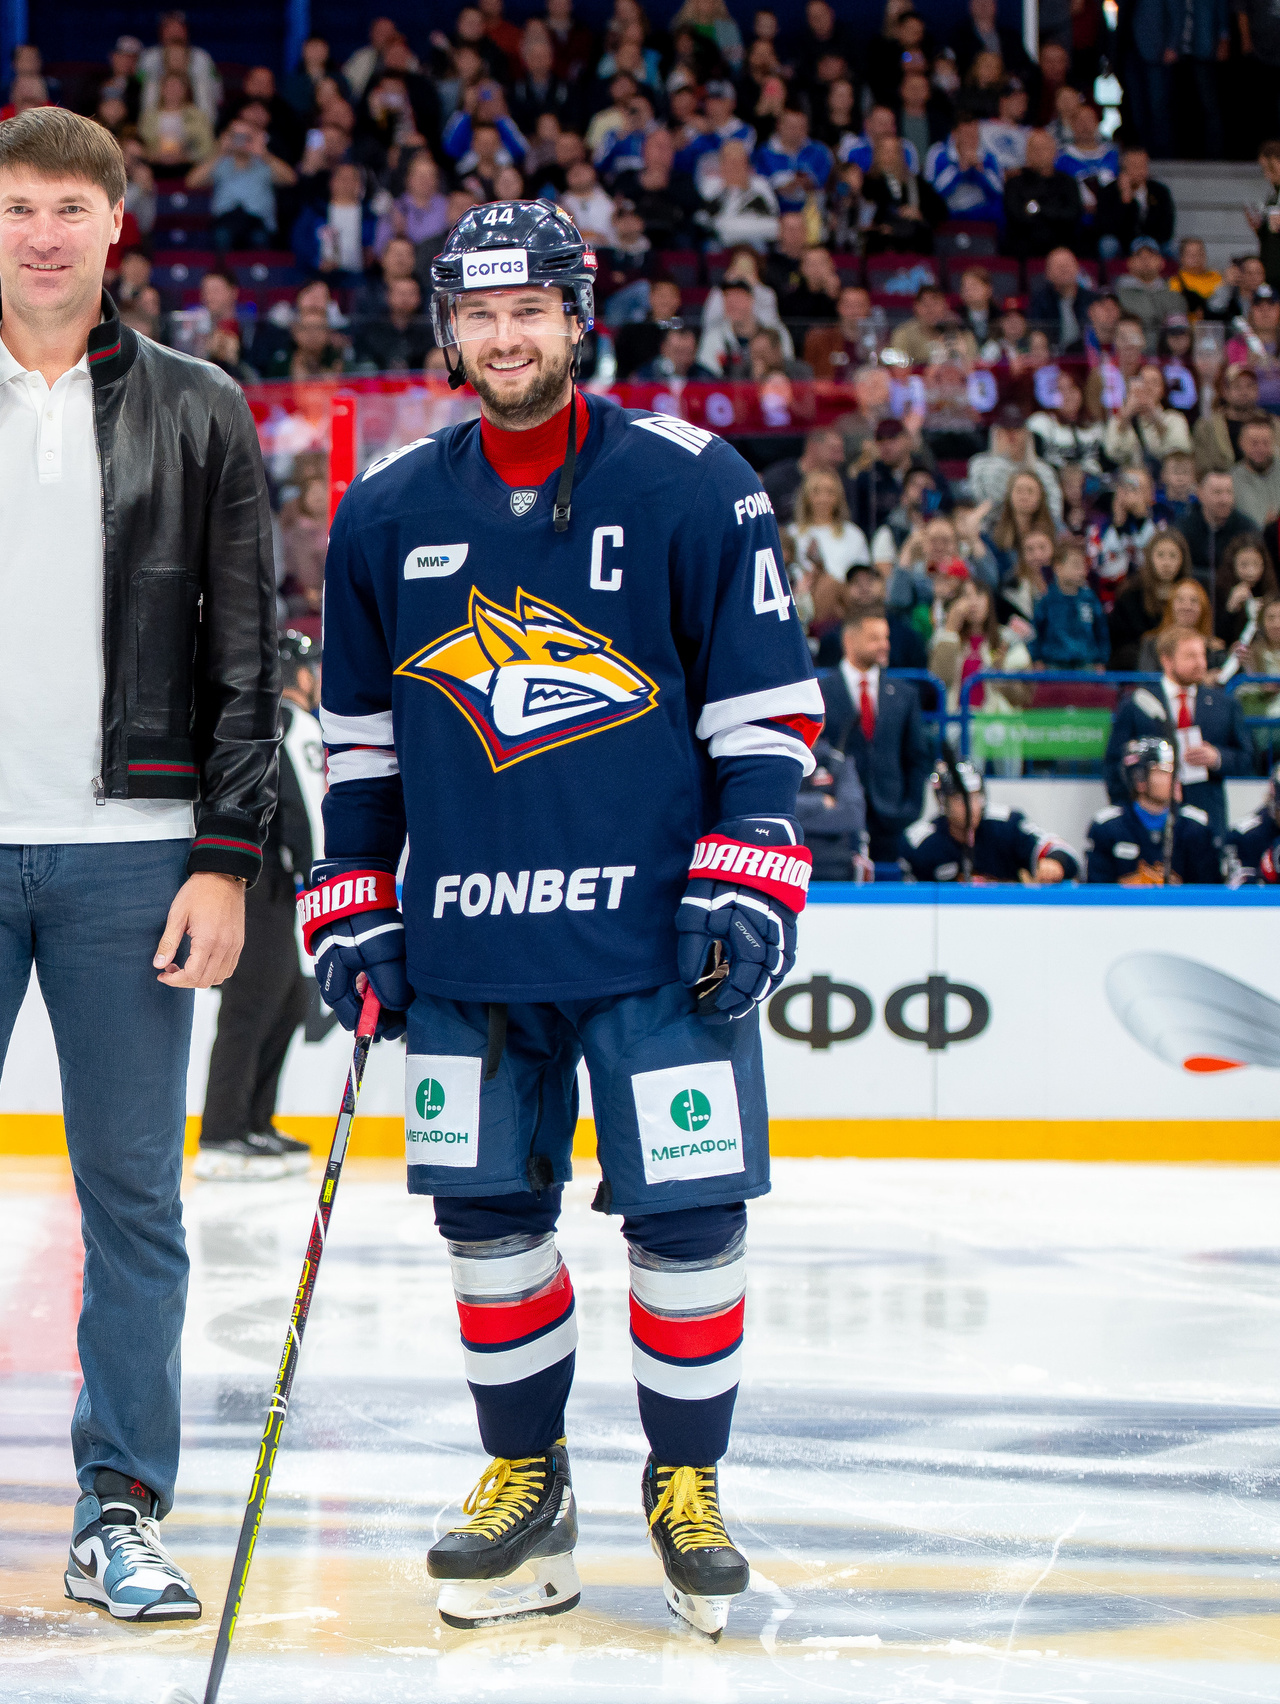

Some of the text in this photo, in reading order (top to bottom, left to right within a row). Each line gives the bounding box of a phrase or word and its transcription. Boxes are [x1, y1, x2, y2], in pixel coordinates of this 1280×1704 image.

[482, 208, 515, 226] 44
[466, 260, 524, 277] согаз
[416, 556, 451, 568] МИР
[590, 525, 624, 591] C
[433, 865, 636, 919] FONBET
[734, 920, 761, 949] COVERT
[324, 961, 335, 992] COVERT
[130, 1489, 146, 1498] AIR
